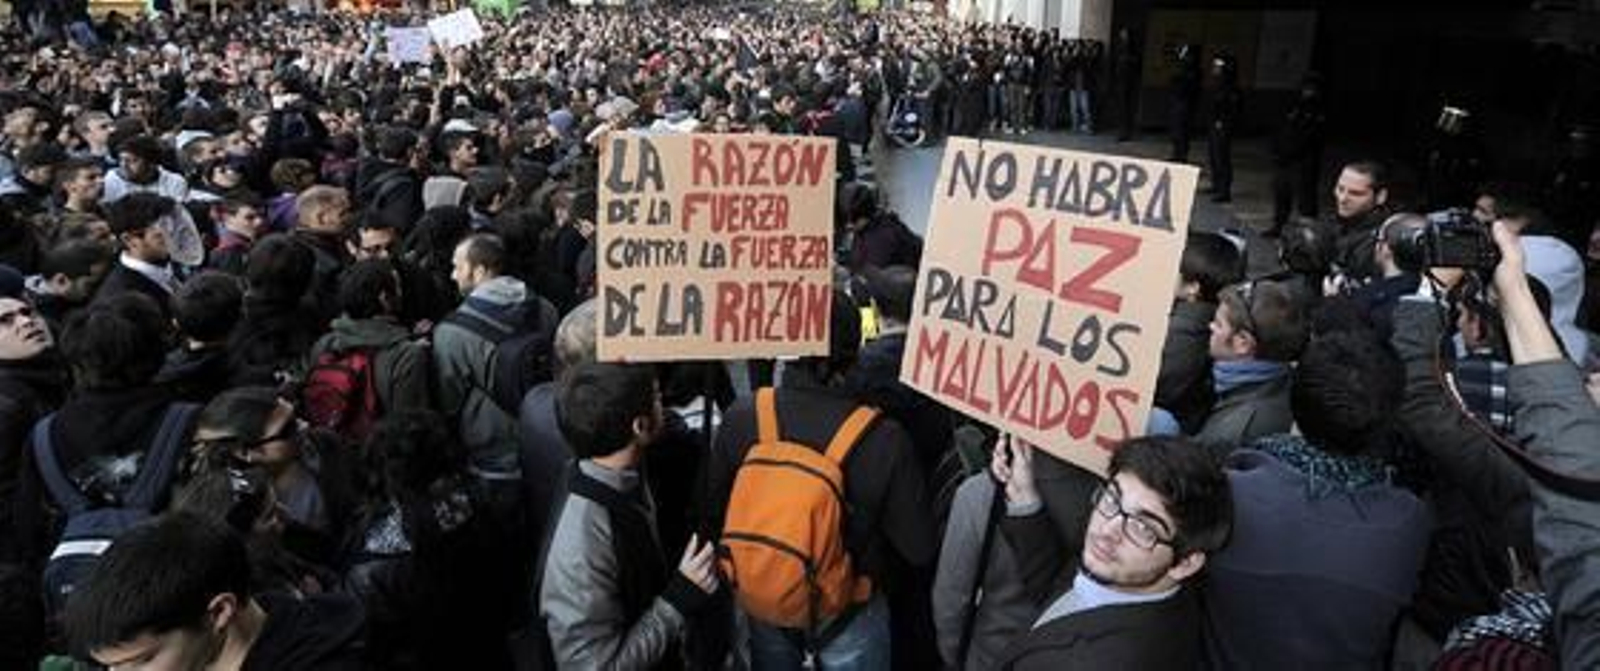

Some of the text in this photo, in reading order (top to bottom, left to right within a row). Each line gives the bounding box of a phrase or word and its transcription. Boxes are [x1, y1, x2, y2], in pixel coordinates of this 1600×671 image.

[606, 138, 829, 193] LA RAZÓN
[948, 150, 1175, 232] NO HABRA
[607, 191, 789, 233] DE LA FUERZA
[605, 235, 828, 270] CONTRA LA FUERZA
[982, 208, 1142, 313] PAZ
[604, 276, 829, 342] DE LA RAZÓN
[922, 268, 1141, 376] PARA LOS
[913, 327, 1139, 450] MALVADOS
